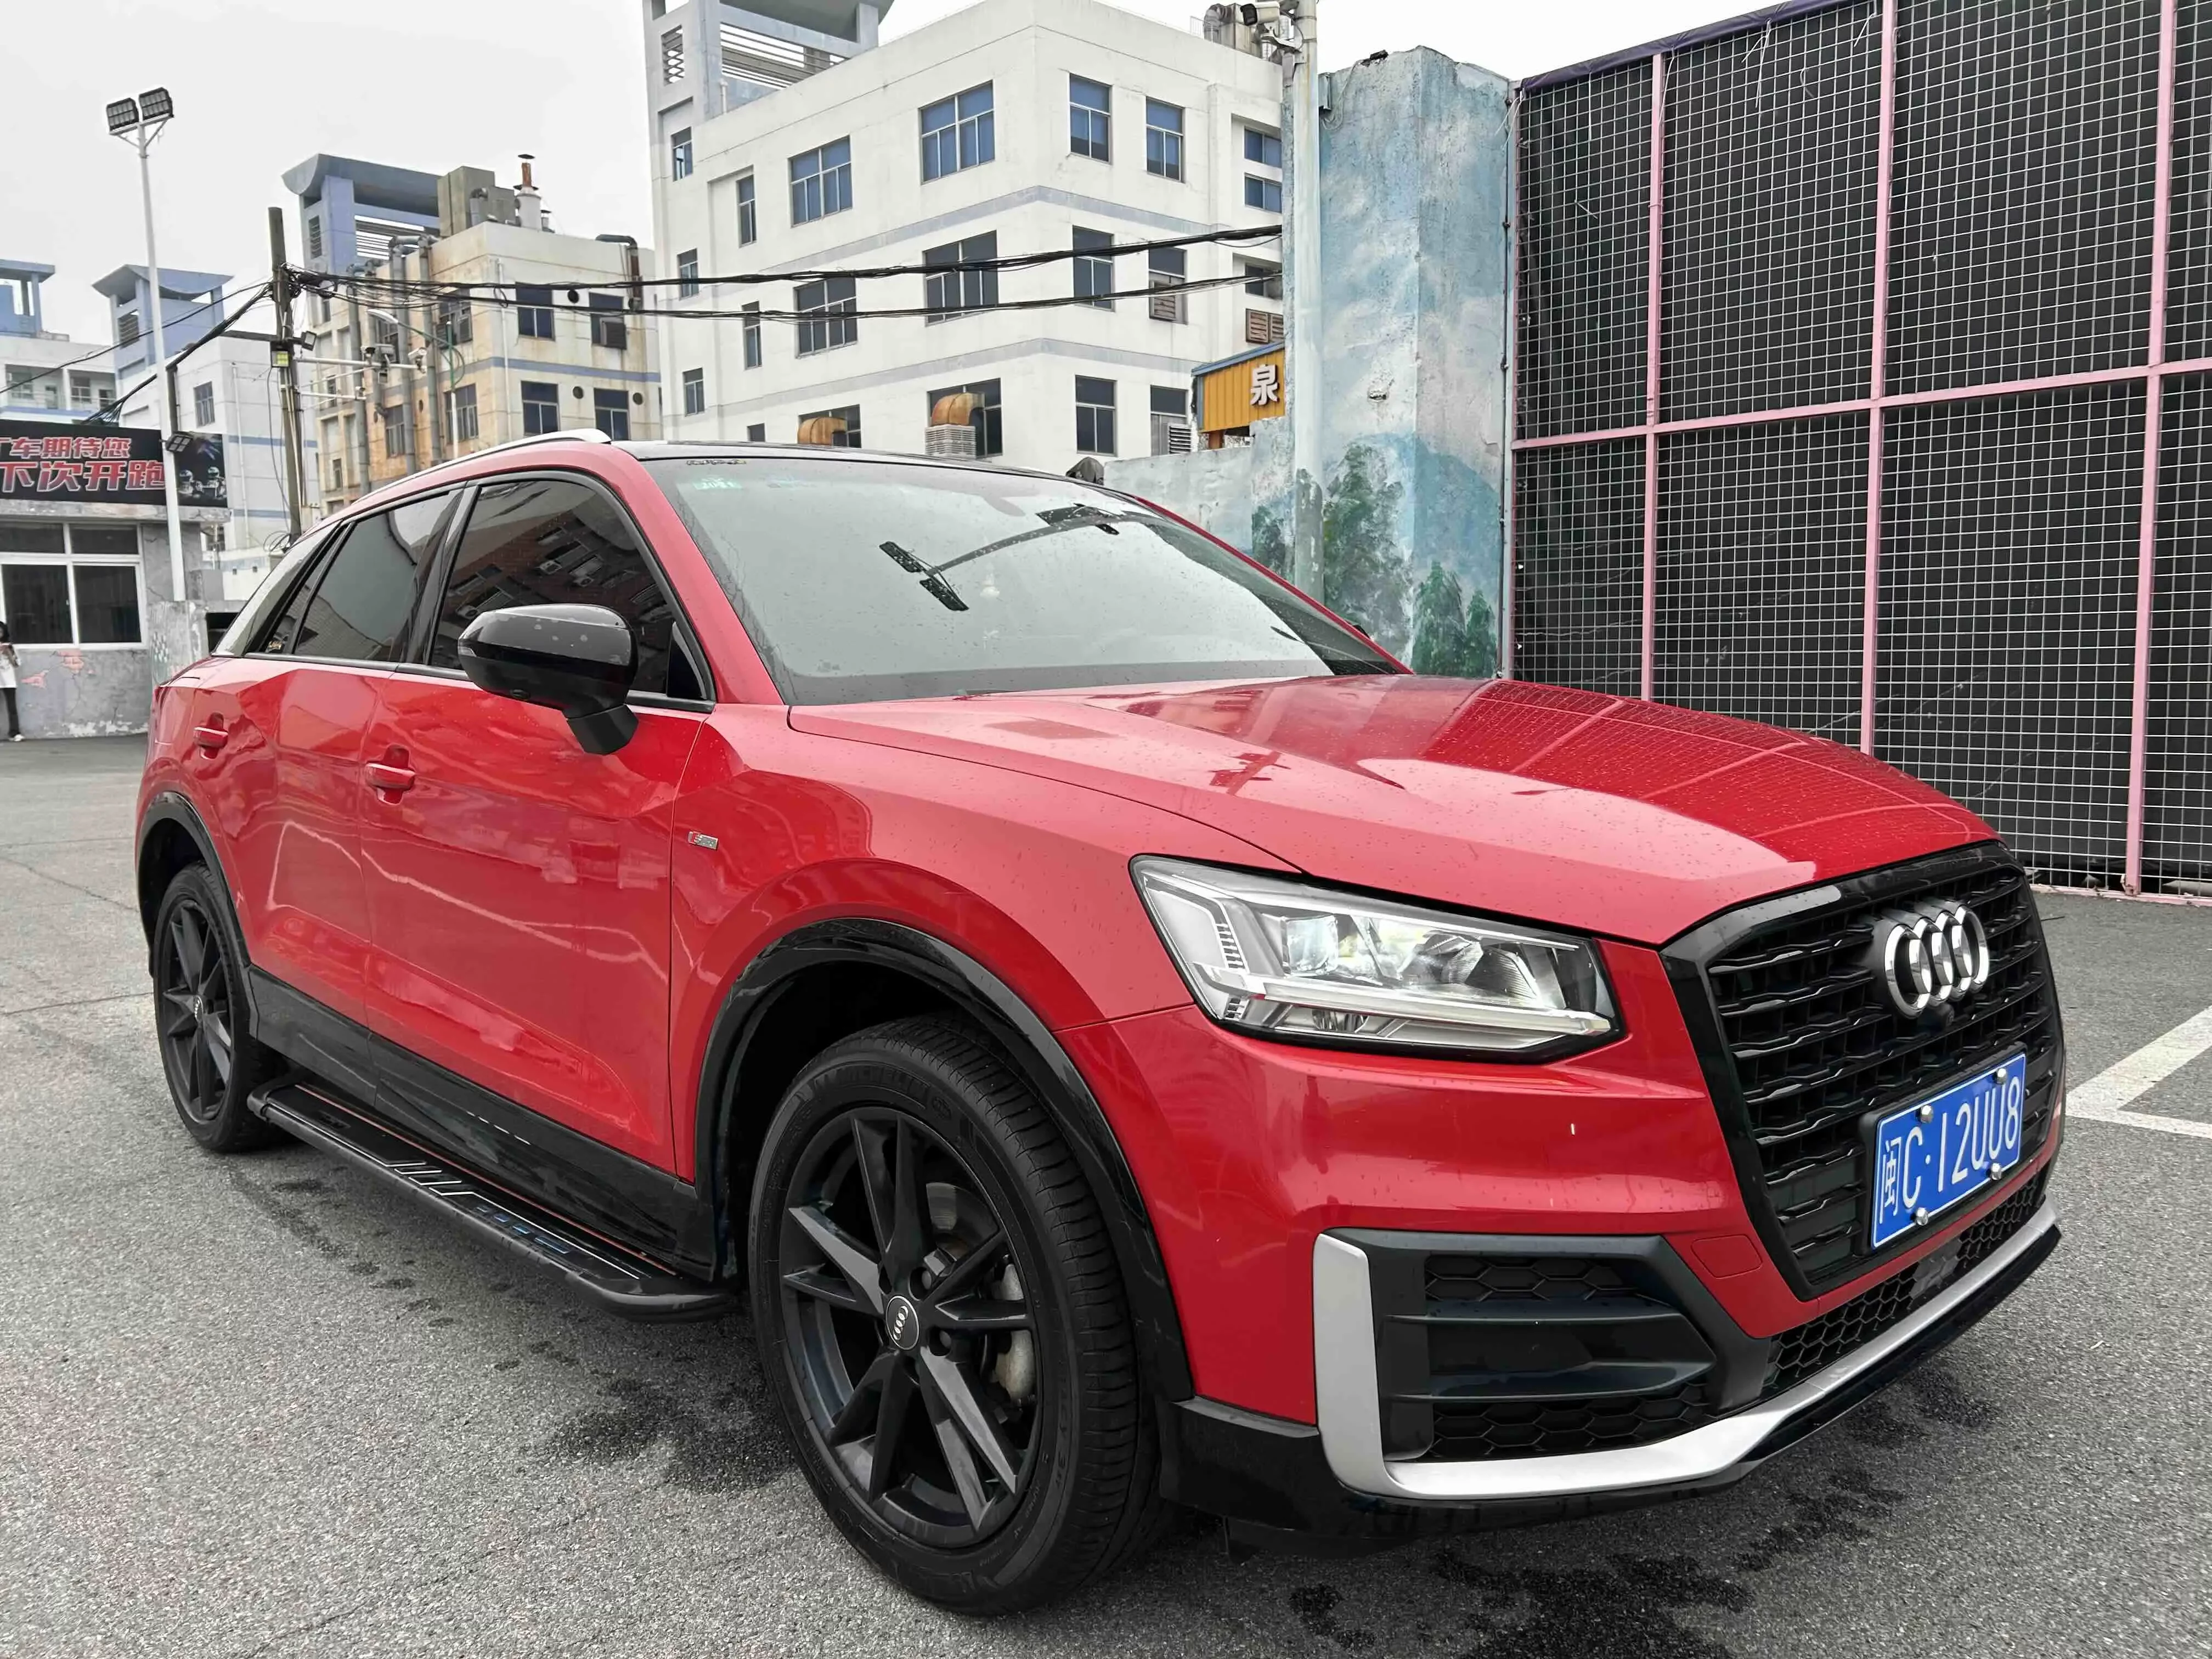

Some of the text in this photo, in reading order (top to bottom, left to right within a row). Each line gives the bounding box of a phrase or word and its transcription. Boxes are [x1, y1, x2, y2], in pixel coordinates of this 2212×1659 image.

[1250, 364, 1279, 405] 泉
[0, 460, 166, 493] 下次开跑
